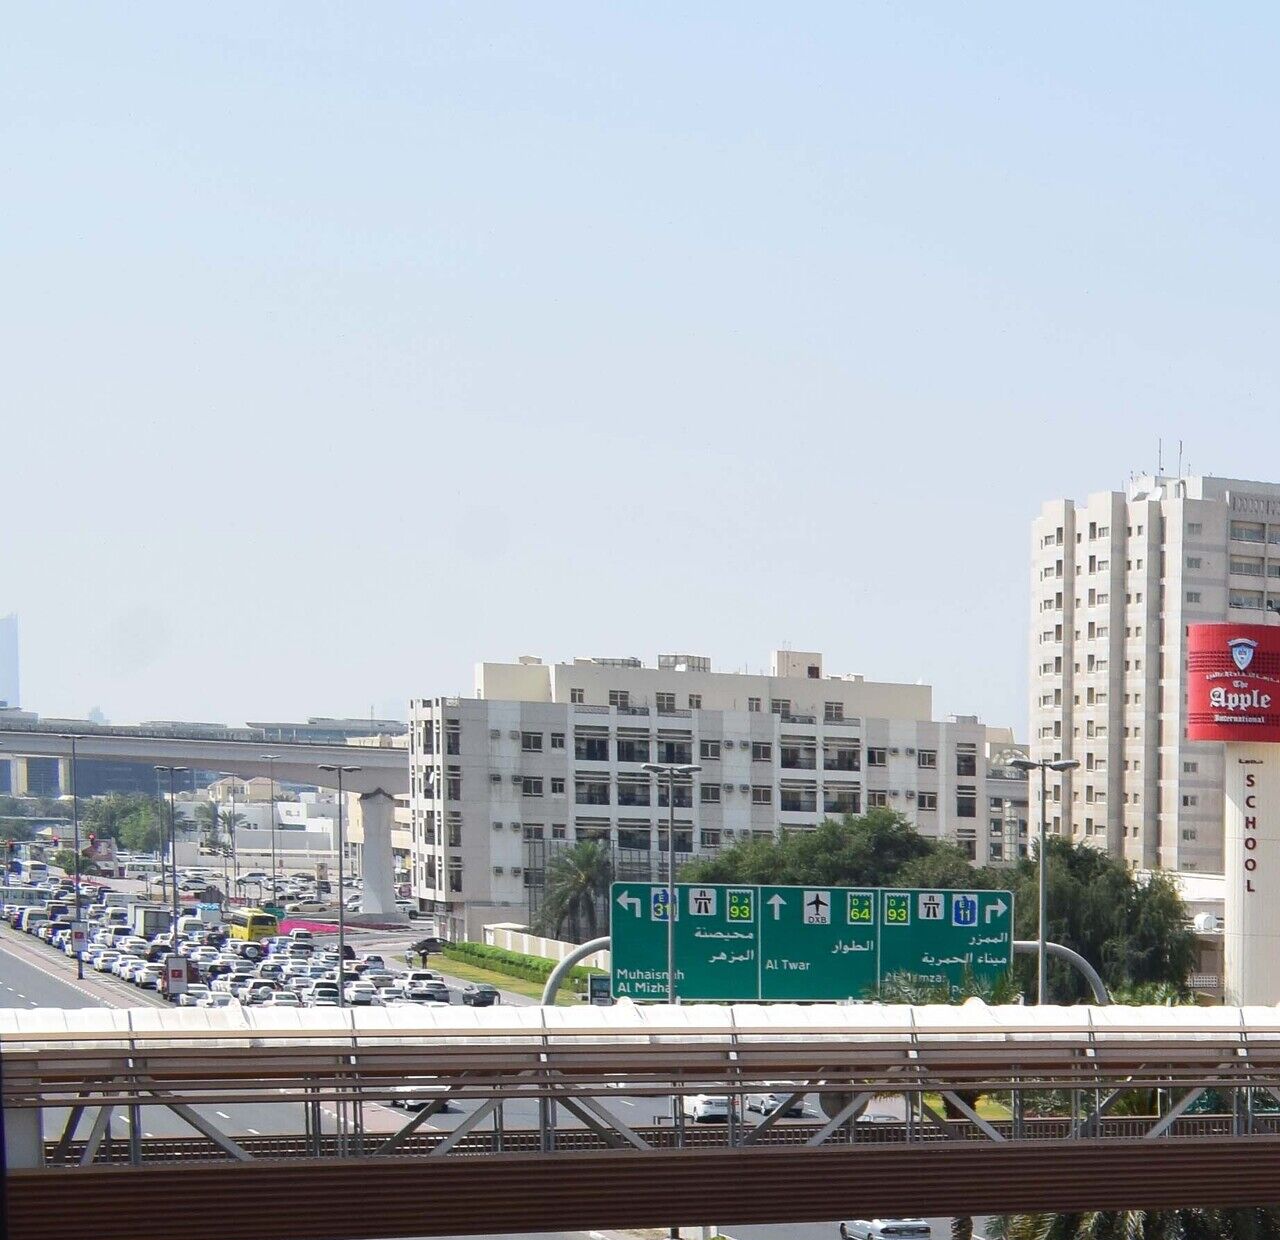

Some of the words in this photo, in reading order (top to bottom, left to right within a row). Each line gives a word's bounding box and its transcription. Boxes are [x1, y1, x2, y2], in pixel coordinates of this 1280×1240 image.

[1232, 680, 1248, 688] The
[1210, 686, 1271, 711] Apple
[1214, 714, 1265, 723] International
[1245, 774, 1256, 892] SCHOOL
[730, 905, 750, 918] 93
[851, 908, 870, 920] 64
[888, 908, 907, 921] 93
[960, 910, 970, 921] 11
[968, 932, 1008, 945] الممزر
[831, 940, 874, 953] الطوار
[709, 949, 754, 963] المزهر
[922, 952, 973, 966] الحمرية
[978, 952, 1007, 966] ميناء
[765, 960, 779, 970] Al
[781, 960, 811, 970] Twar
[617, 969, 684, 980] Muhaisnh
[618, 982, 631, 993] Al
